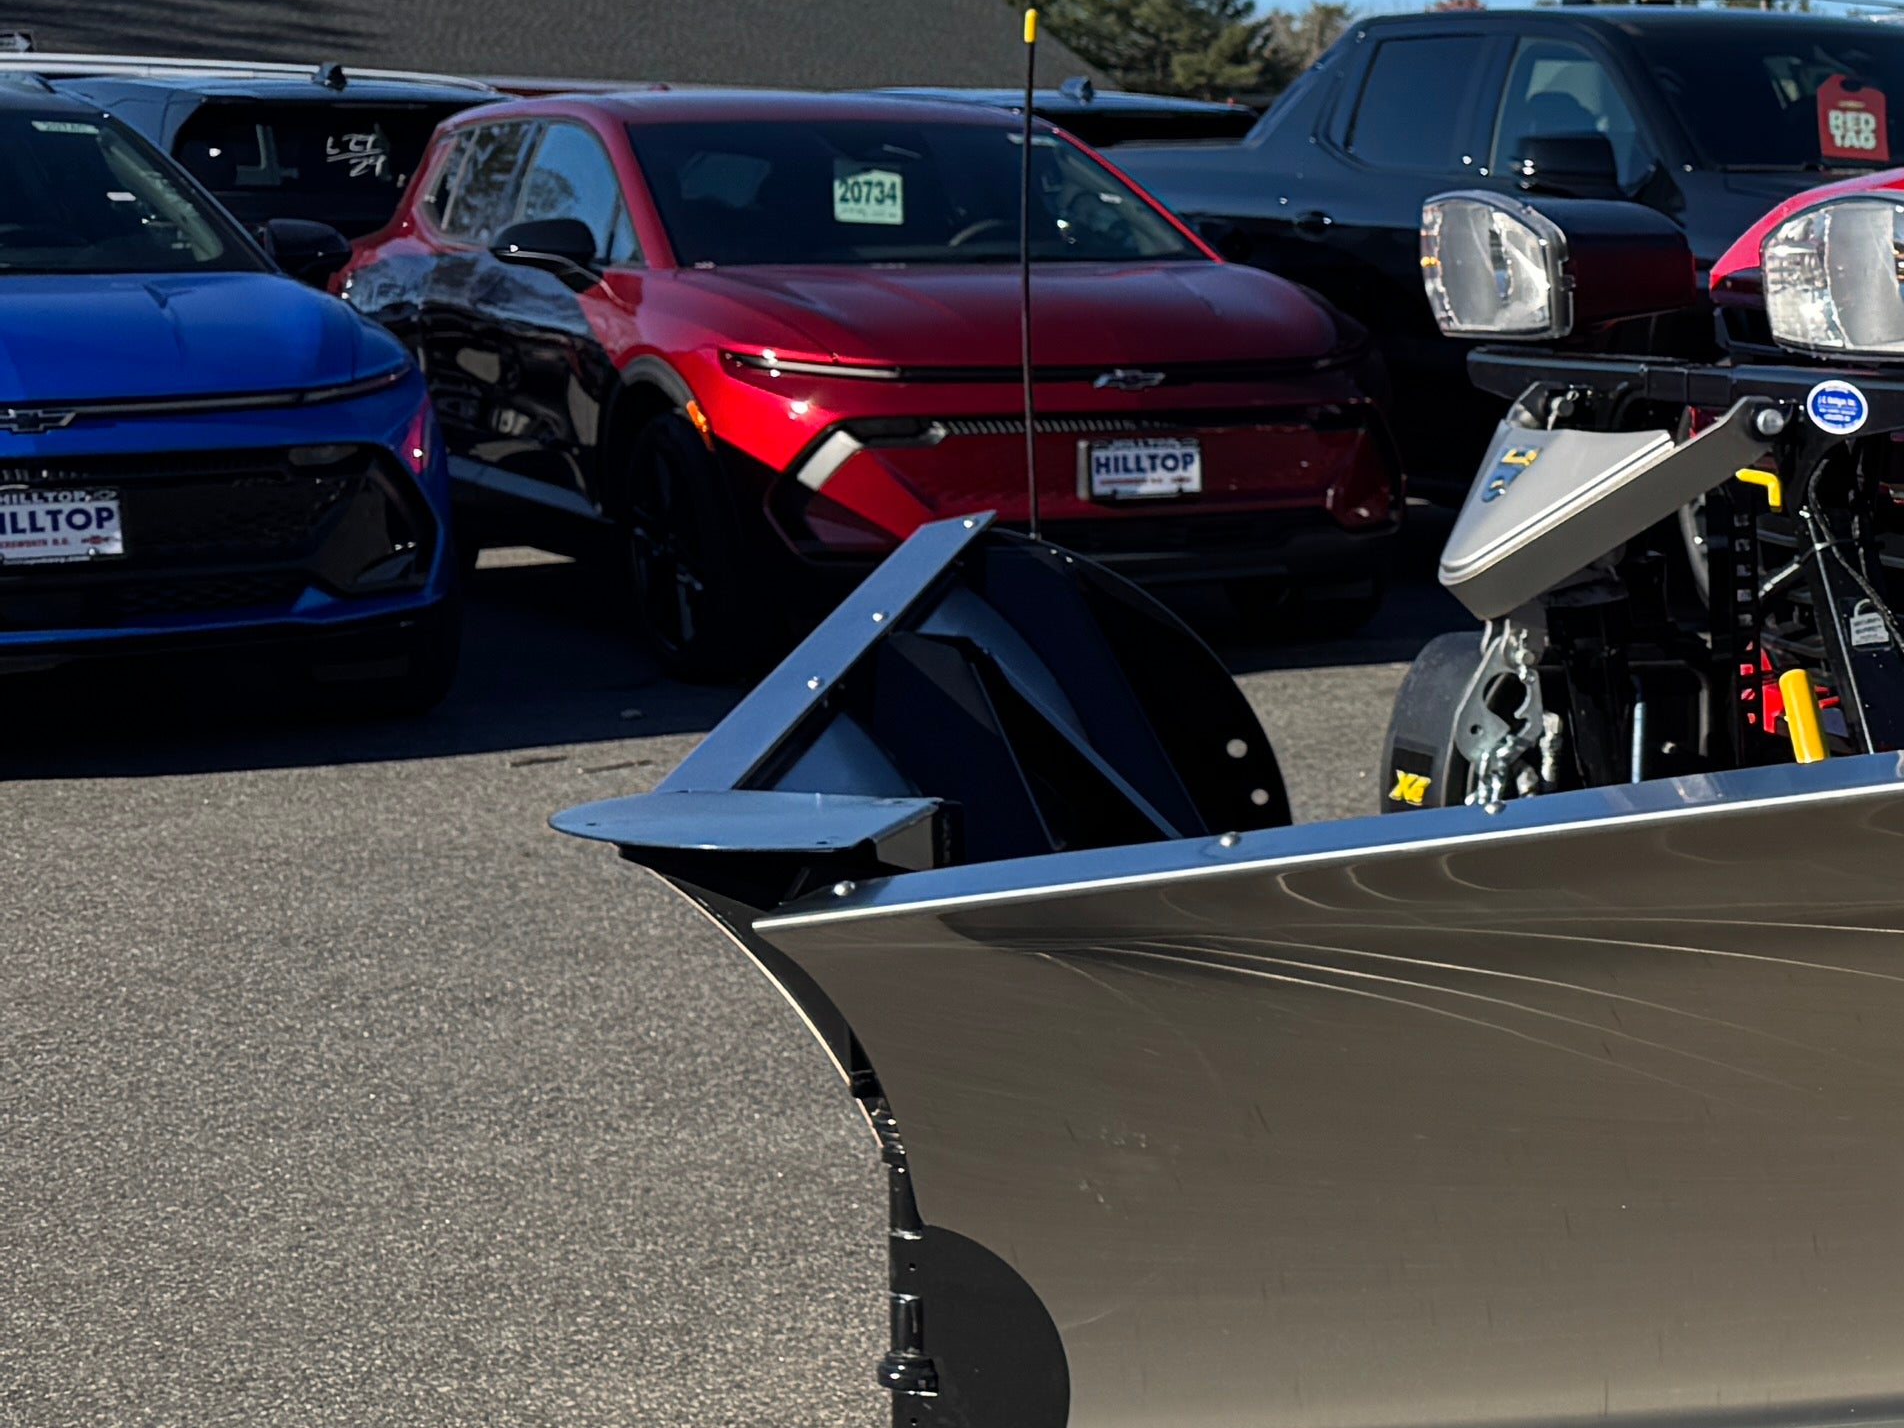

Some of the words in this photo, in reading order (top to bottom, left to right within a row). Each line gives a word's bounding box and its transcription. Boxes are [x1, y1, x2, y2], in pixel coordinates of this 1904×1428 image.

[1828, 109, 1876, 134] RED
[838, 179, 898, 205] 20734
[1094, 452, 1195, 475] HILLTOP
[0, 506, 115, 535] ILLTOP
